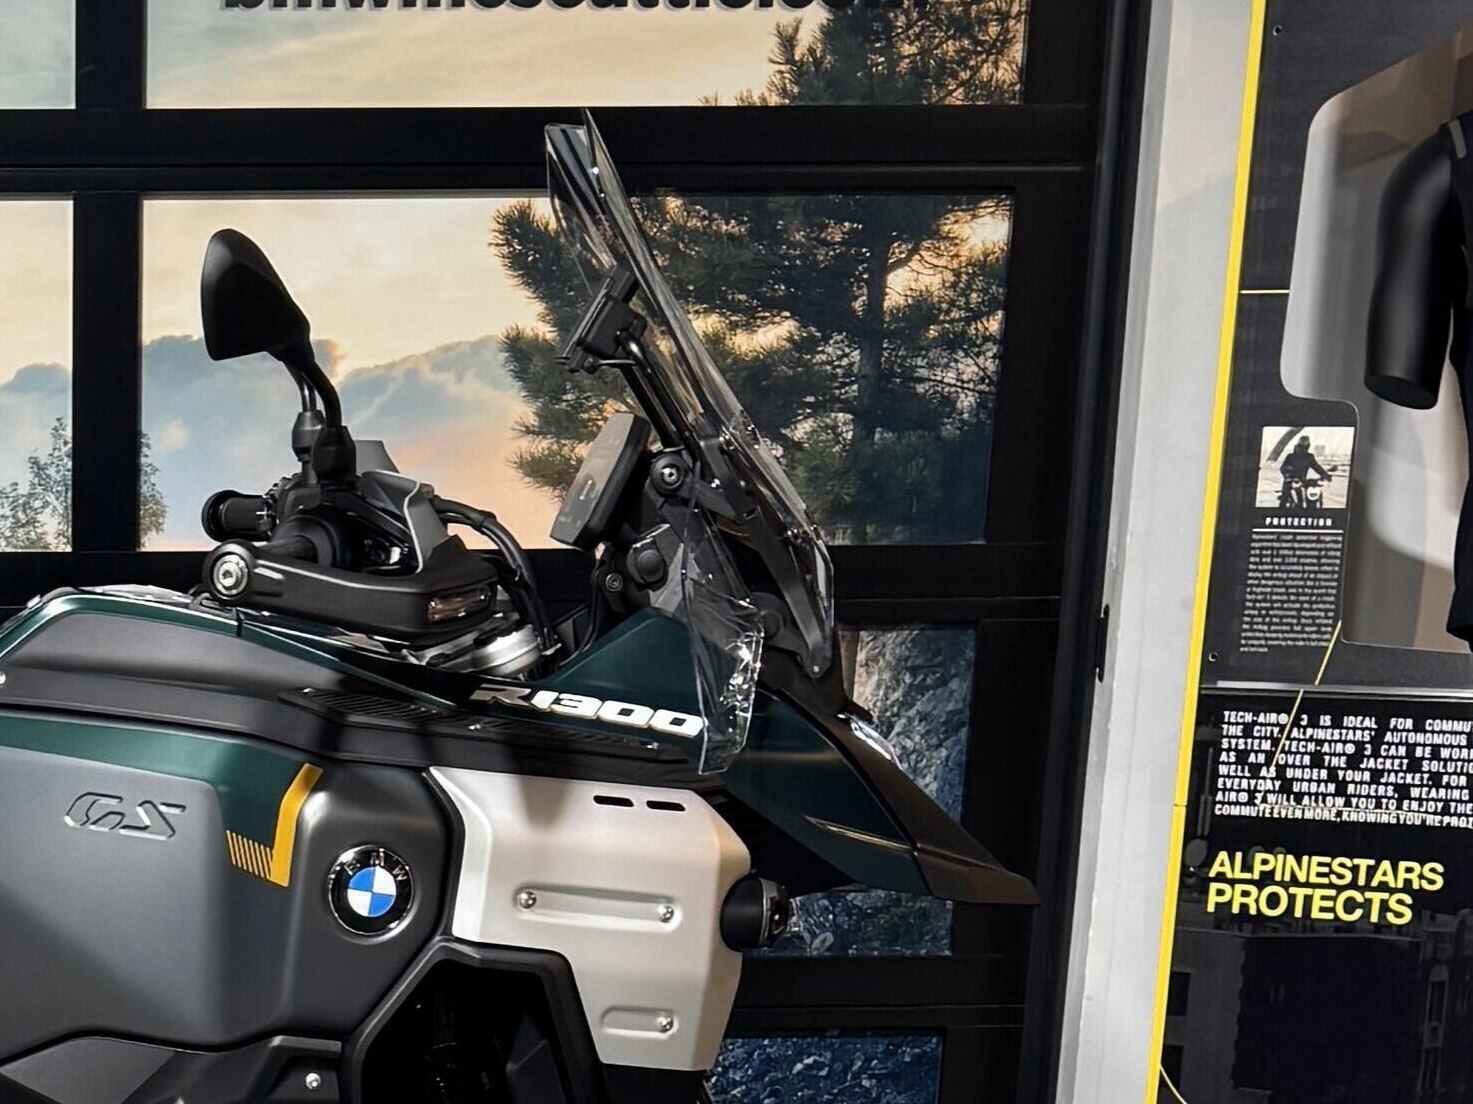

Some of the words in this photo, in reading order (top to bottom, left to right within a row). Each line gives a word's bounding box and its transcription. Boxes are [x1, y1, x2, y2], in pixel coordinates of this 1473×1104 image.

[1265, 517, 1332, 526] PROTECTION
[1300, 714, 1308, 726] 3
[1319, 715, 1331, 726] IS
[1343, 716, 1378, 728] IDEAL
[1389, 718, 1413, 730] FOR
[1425, 720, 1473, 732] COMMU
[1221, 724, 1243, 736] THE
[1253, 726, 1281, 738] CITY.
[1384, 732, 1467, 746] AUTONOMOUS
[1221, 738, 1275, 751] SYSTEM.
[1363, 744, 1371, 755] 3
[1381, 745, 1407, 756] CAN
[1415, 746, 1431, 758] BE
[1219, 751, 1237, 762] AS
[1248, 752, 1265, 764] AN
[1278, 754, 1311, 765] OVER
[1323, 756, 1347, 768] THE
[1359, 758, 1409, 770] JACKET
[1219, 764, 1251, 776] WELL
[1259, 766, 1277, 778] AS
[1286, 768, 1328, 780] UNDER
[1337, 770, 1371, 782] YOUR
[1380, 772, 1433, 785] JACKET.
[1442, 776, 1467, 786] FOR
[1217, 778, 1281, 791] EVERYDAY
[1293, 781, 1335, 794] URBAN
[1347, 784, 1399, 798] RIDERS,
[1410, 787, 1469, 800] WEARING
[1215, 804, 1271, 818] COMMUTE
[1273, 806, 1302, 819] EVEN
[1304, 806, 1340, 823] MORE,
[1342, 811, 1397, 824] KNOWING
[1267, 794, 1297, 806] WILL
[1301, 795, 1345, 808] ALLOW
[1351, 798, 1375, 809] YOU
[1381, 799, 1397, 810] TO
[1403, 800, 1445, 812] ENJOY
[1449, 802, 1473, 814] THE
[64, 791, 186, 841] GS
[1208, 850, 1445, 891] ALPINESTARS
[1206, 882, 1413, 925] PROTECTS
